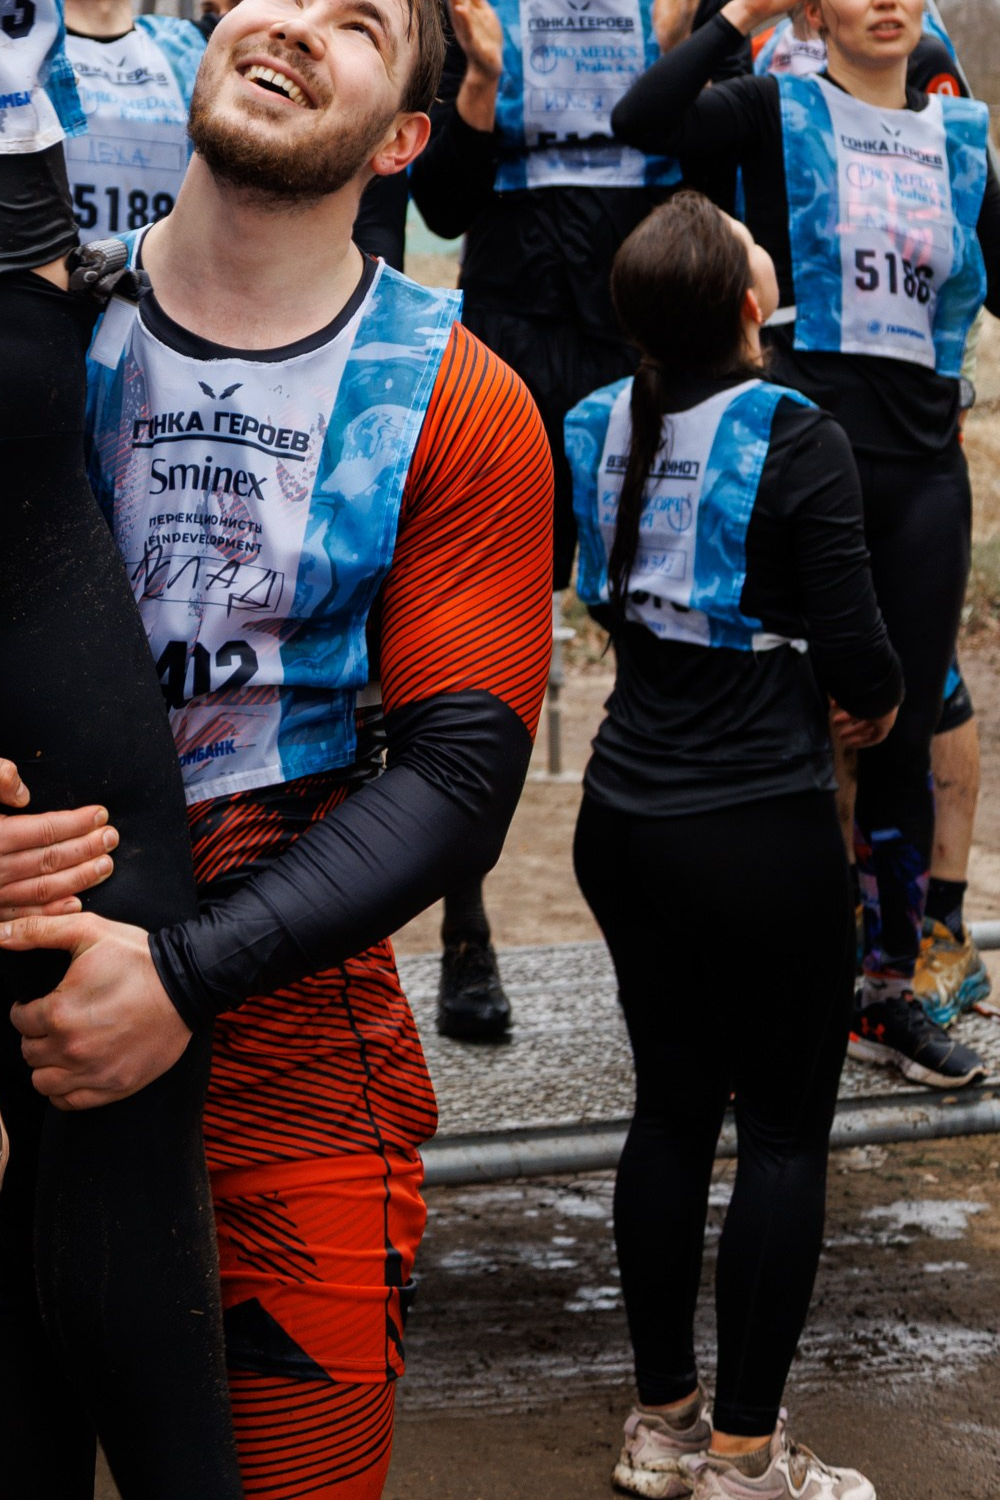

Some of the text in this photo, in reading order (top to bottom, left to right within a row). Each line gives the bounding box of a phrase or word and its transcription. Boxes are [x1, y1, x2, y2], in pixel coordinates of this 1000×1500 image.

[529, 16, 635, 29] ГОНКА ГЕРОЕВ
[841, 134, 890, 152] ГОНКА
[214, 411, 310, 453] ГЕРОЕВ
[149, 455, 268, 501] Sminex
[155, 640, 259, 714] 412
